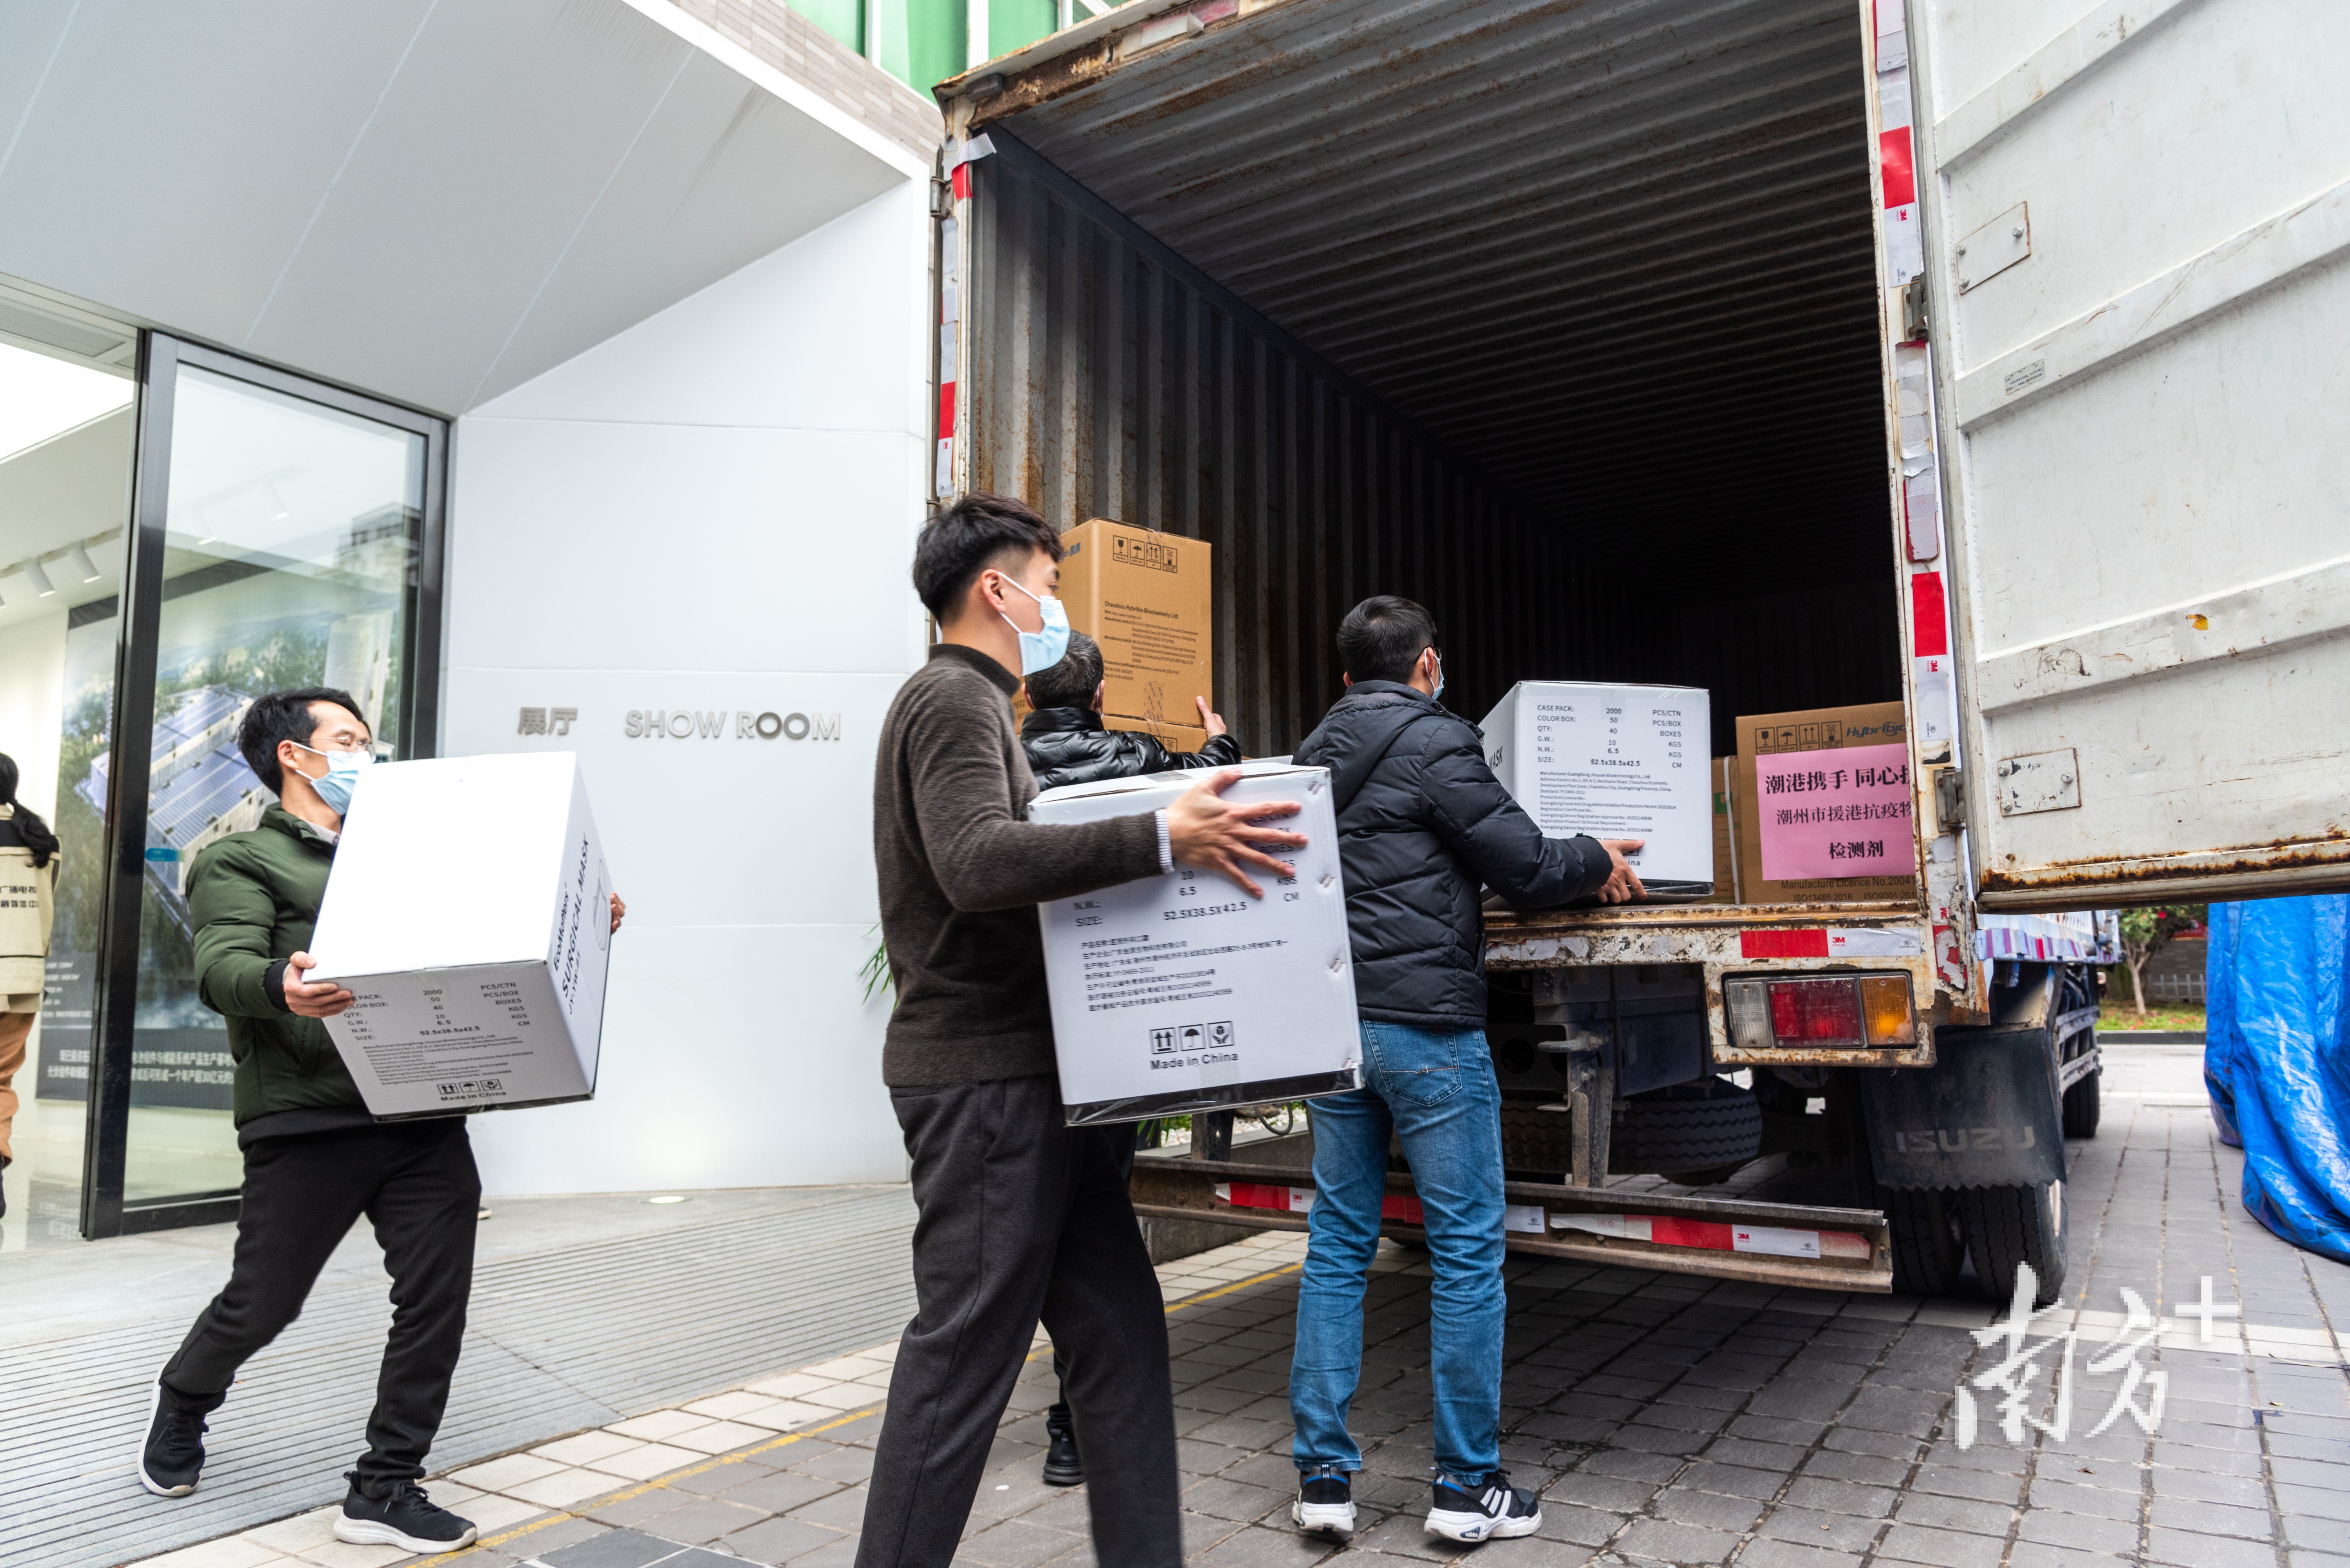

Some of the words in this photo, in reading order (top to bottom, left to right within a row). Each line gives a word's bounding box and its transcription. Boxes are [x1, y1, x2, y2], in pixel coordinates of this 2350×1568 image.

[1899, 209, 1907, 221] 3M
[1931, 660, 1938, 672] 3M
[518, 707, 578, 736] 展厅
[626, 710, 727, 738] SHOW
[737, 712, 841, 740] ROOM
[1765, 769, 1848, 794] 潮港携手
[1829, 840, 1884, 860] 检测剂
[1181, 870, 1194, 880] 10
[1781, 879, 1834, 889] Manufacture
[1837, 877, 1870, 887] Licence
[1179, 886, 1197, 897] 6.5
[1794, 892, 1853, 902] ISO13485:2016
[563, 893, 582, 998] SURGICAL
[578, 832, 588, 893] MASK
[1076, 916, 1103, 927] SIZE:
[1283, 892, 1300, 902] CM
[1939, 907, 1947, 920] 3M
[420, 1026, 480, 1035] 52.5x38.5x42.5
[1150, 1059, 1183, 1070] Made
[1186, 1056, 1198, 1067] in
[1201, 1052, 1238, 1064] China
[1896, 1125, 2035, 1152] ISUZU
